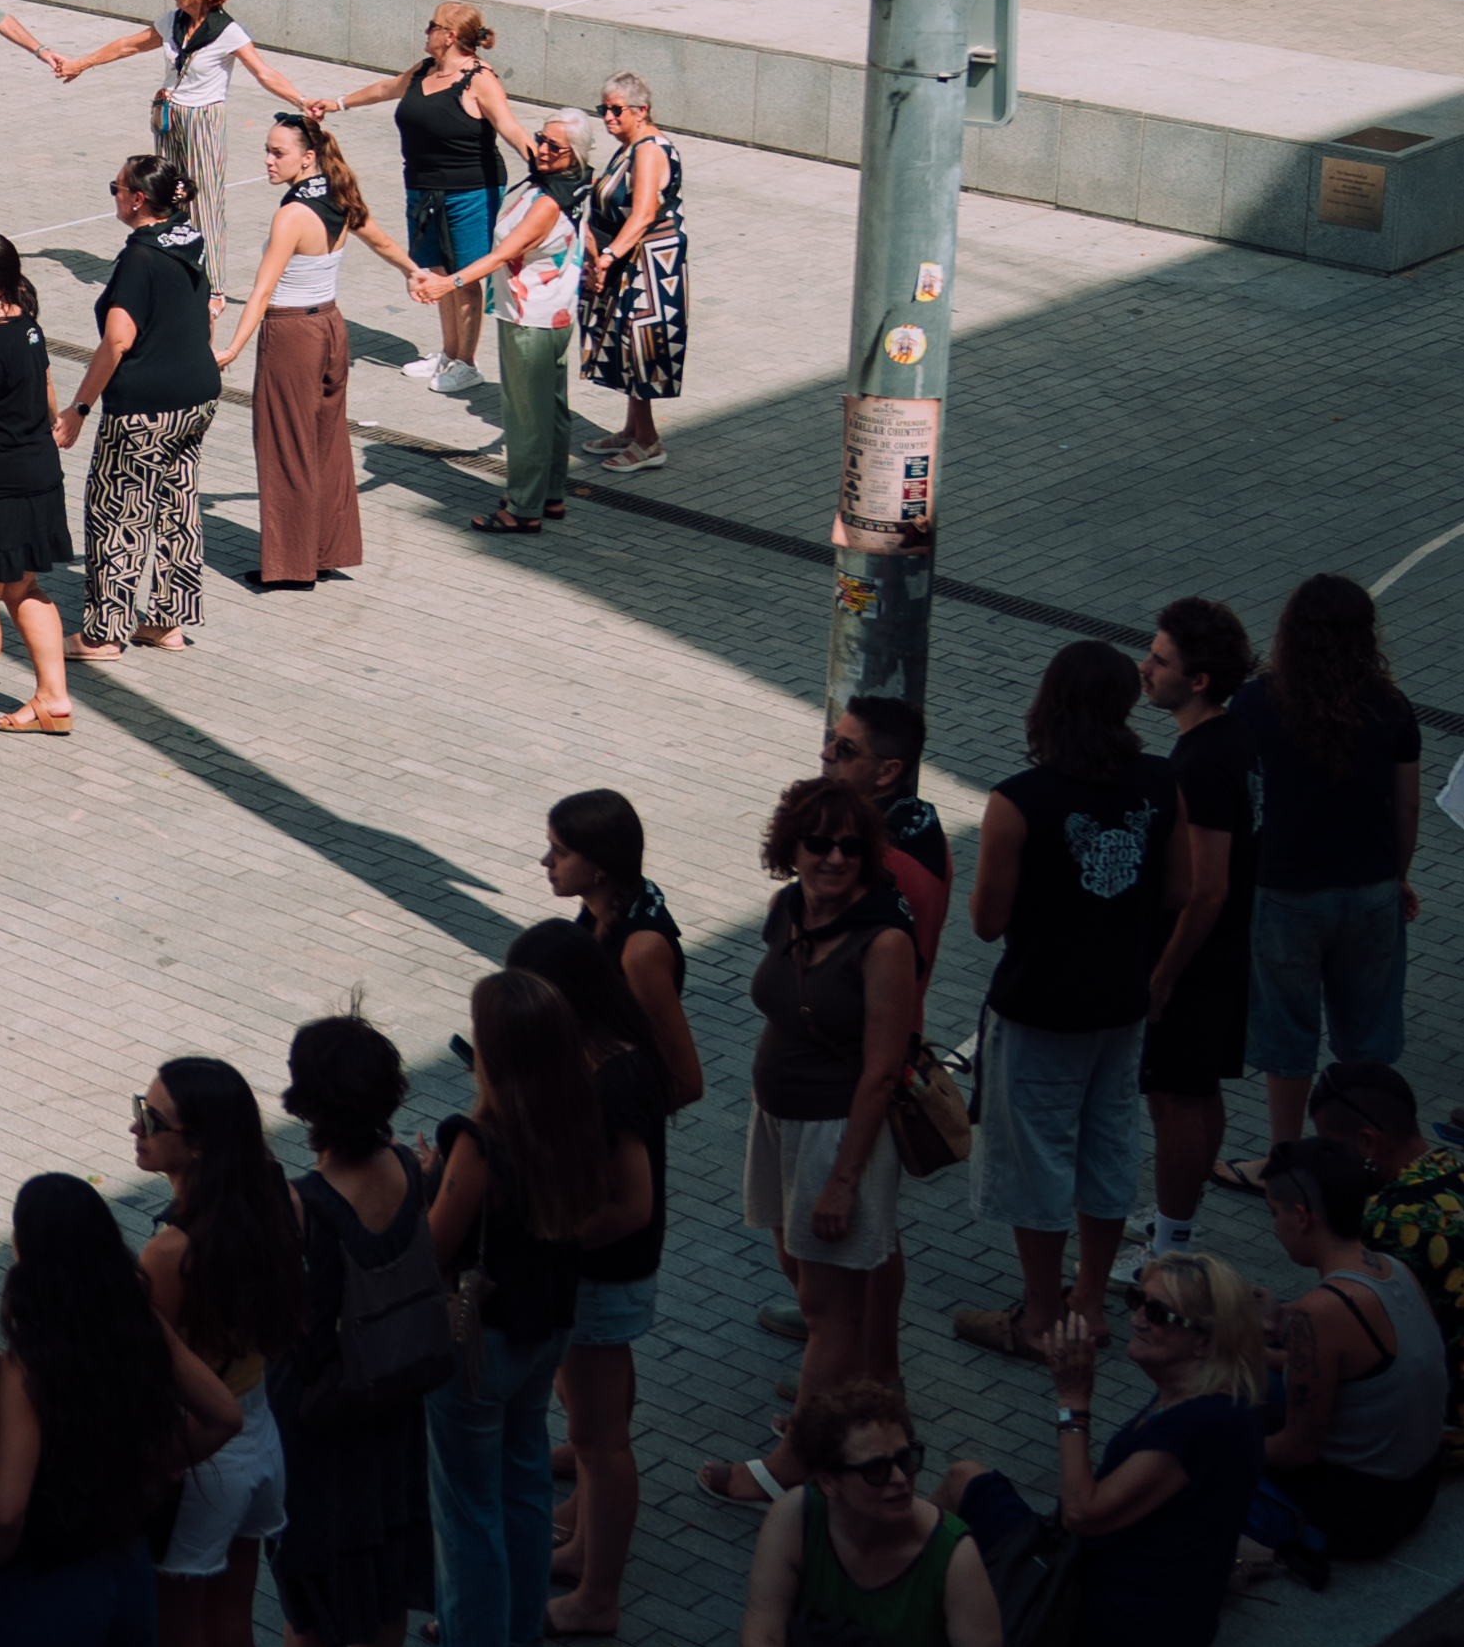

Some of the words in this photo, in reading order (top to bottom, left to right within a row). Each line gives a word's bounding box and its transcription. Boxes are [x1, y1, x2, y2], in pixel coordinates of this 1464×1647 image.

[854, 420, 884, 435] BALLAR
[849, 433, 877, 447] CLASSES
[880, 440, 891, 449] DE
[893, 441, 928, 450] COUNTRY
